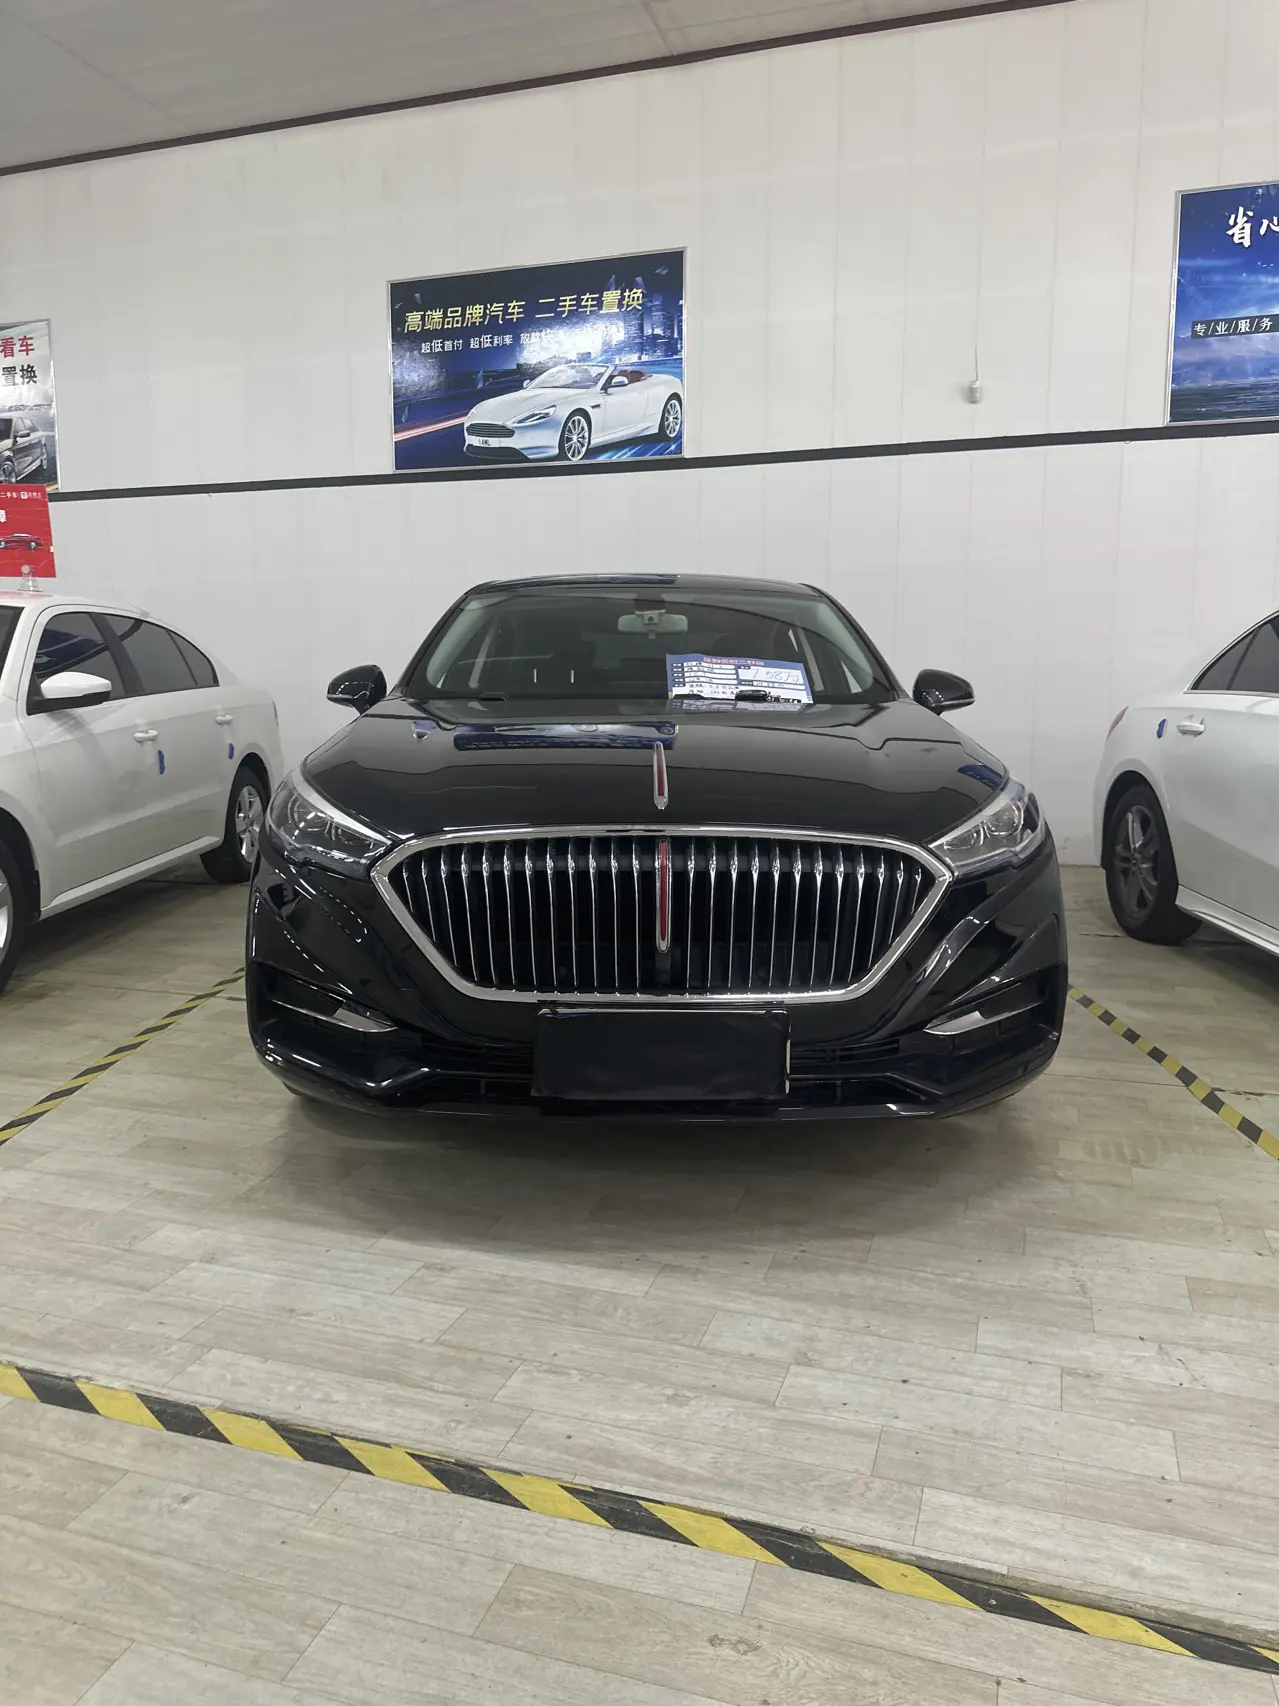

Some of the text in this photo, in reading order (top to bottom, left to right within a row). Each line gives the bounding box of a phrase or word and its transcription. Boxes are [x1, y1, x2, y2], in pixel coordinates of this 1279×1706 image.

[404, 288, 643, 333] 高端品牌汽车 二手车置换
[0, 336, 35, 358] 看车
[421, 339, 463, 354] 超低首付
[470, 334, 513, 349] 超低利率
[2, 364, 38, 386] 置换
